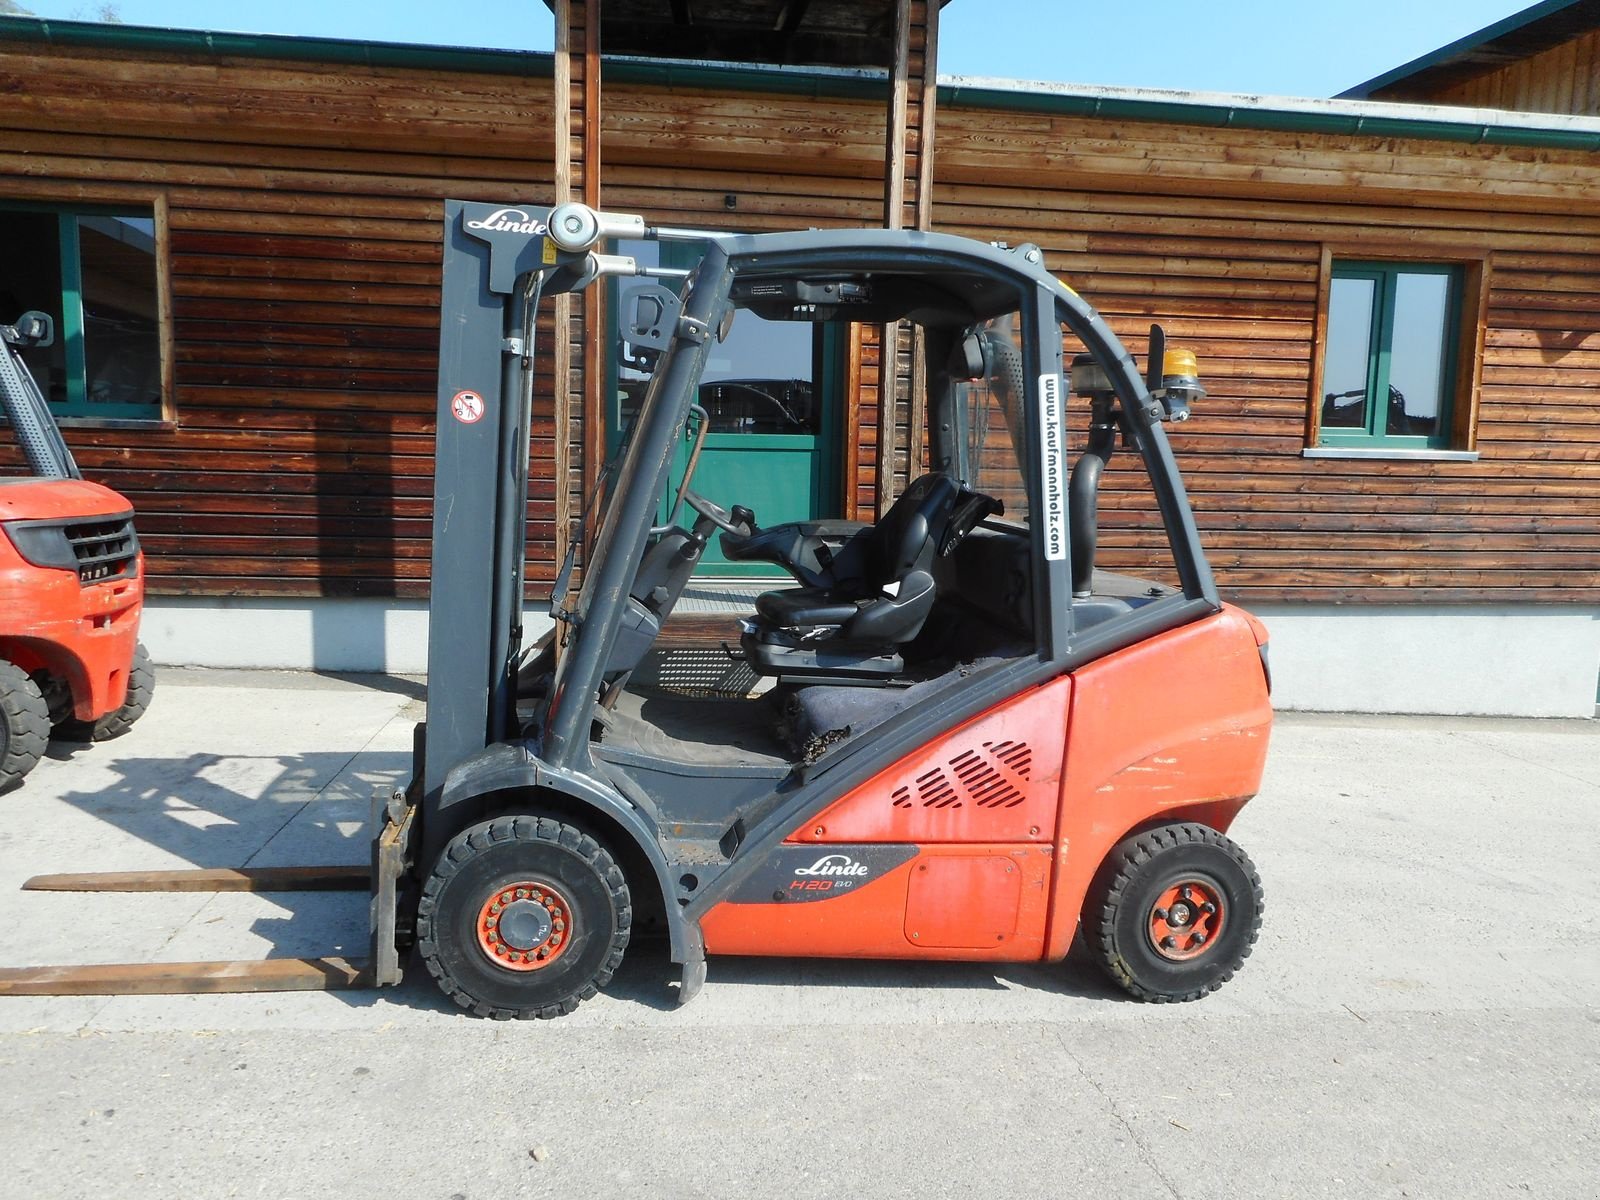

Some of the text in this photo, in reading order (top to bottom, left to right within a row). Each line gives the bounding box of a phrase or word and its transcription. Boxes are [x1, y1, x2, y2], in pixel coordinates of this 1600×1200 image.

[467, 208, 547, 235] Linde
[1045, 378, 1060, 554] www.kaufmannholz.com
[795, 854, 868, 876] Linde
